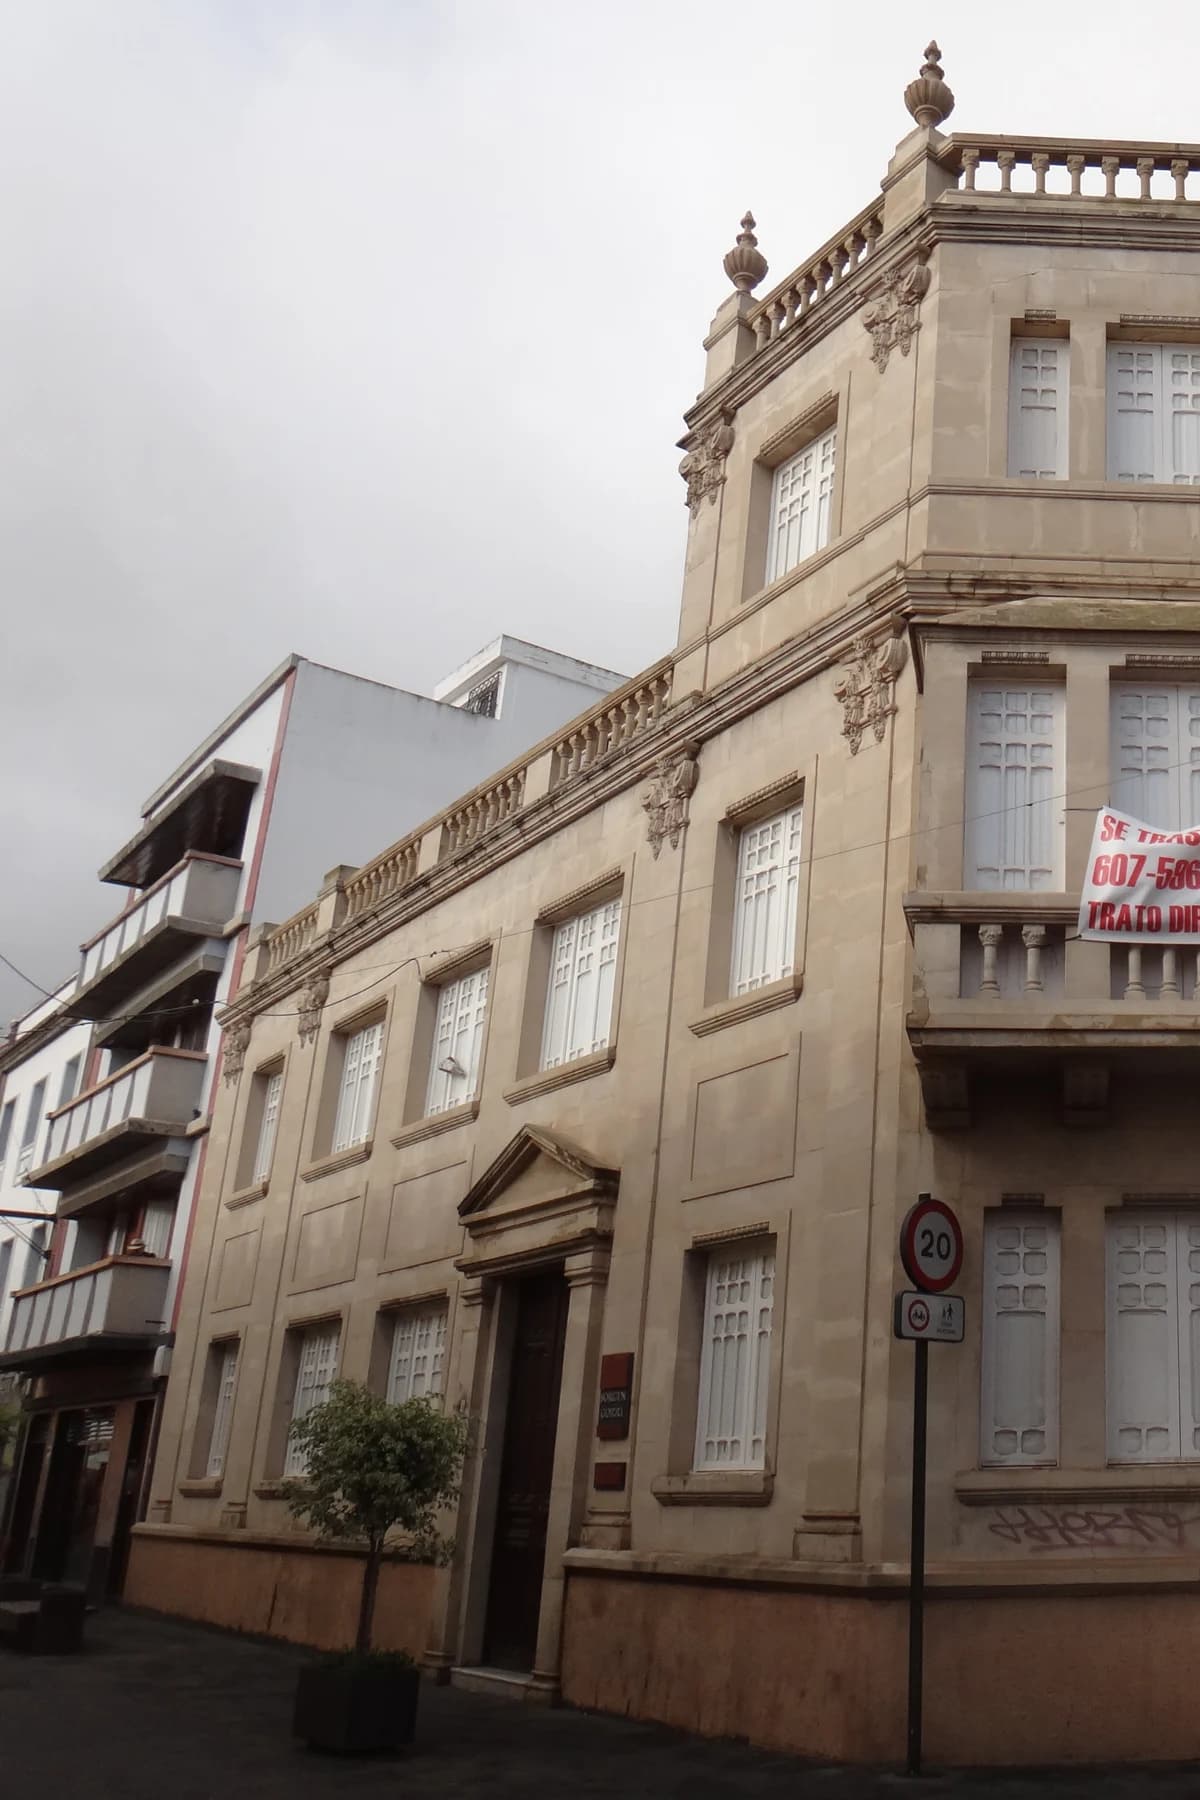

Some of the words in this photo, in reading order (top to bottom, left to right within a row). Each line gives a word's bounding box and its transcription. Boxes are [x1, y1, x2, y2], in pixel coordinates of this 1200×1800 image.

[1100, 815, 1130, 842] SE
[1087, 901, 1162, 932] TRATO
[920, 1229, 951, 1261] 20
